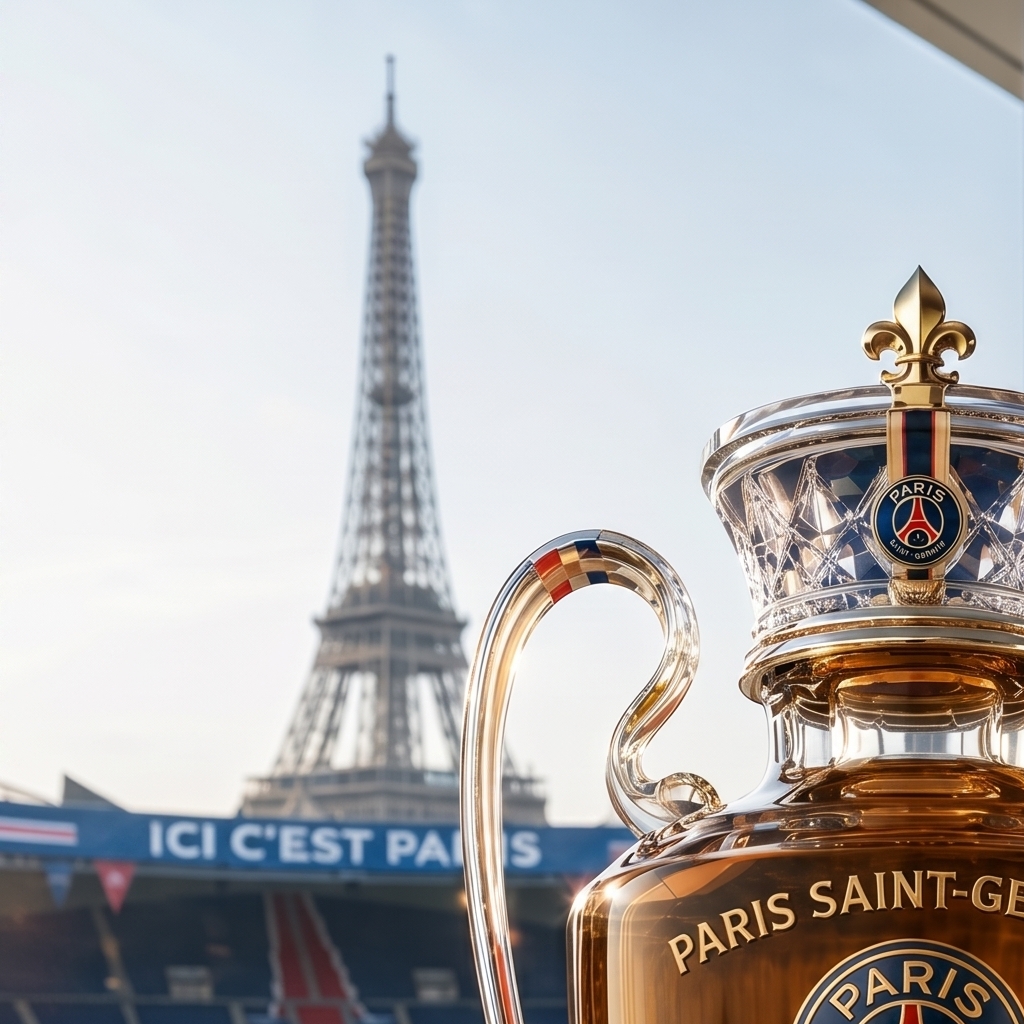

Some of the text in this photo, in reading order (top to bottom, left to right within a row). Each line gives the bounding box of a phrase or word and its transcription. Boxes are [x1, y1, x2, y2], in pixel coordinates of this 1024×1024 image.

[888, 481, 946, 505] PARIS
[149, 820, 217, 860] ICI
[229, 823, 374, 866] C'EST
[667, 891, 797, 976] PARIS
[828, 960, 992, 1021] PARIS
